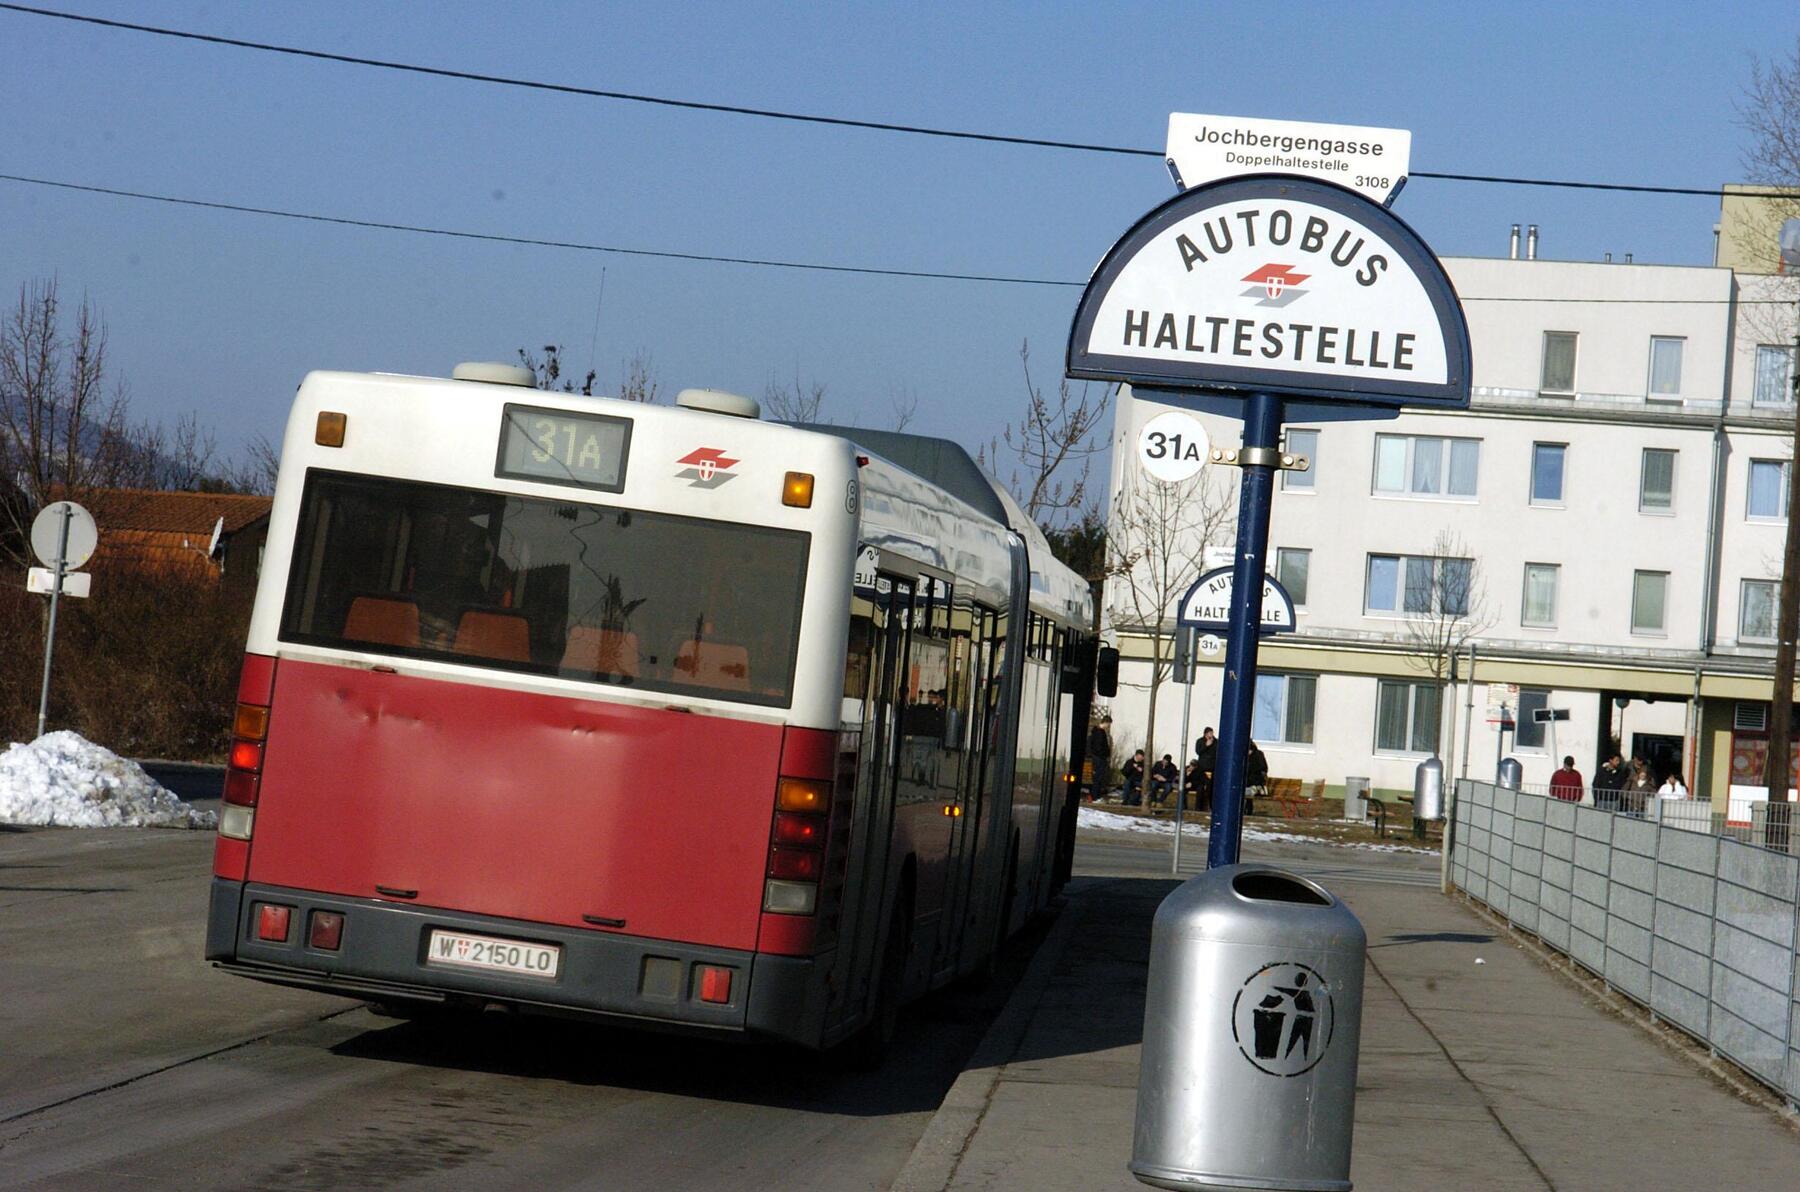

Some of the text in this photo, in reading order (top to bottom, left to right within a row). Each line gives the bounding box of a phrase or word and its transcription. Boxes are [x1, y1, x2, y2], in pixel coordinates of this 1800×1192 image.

[1194, 125, 1385, 157] Jochbergengasse
[1225, 151, 1350, 173] Doppelhaltestelle
[1354, 175, 1390, 190] 3108
[1175, 208, 1389, 287] AUTOBUS
[1122, 309, 1416, 371] HALTESTELLE
[531, 417, 601, 470] 31A
[1146, 431, 1200, 462] 31A
[1201, 639, 1218, 651] 31A
[440, 937, 455, 957] W
[472, 942, 520, 966] 2150
